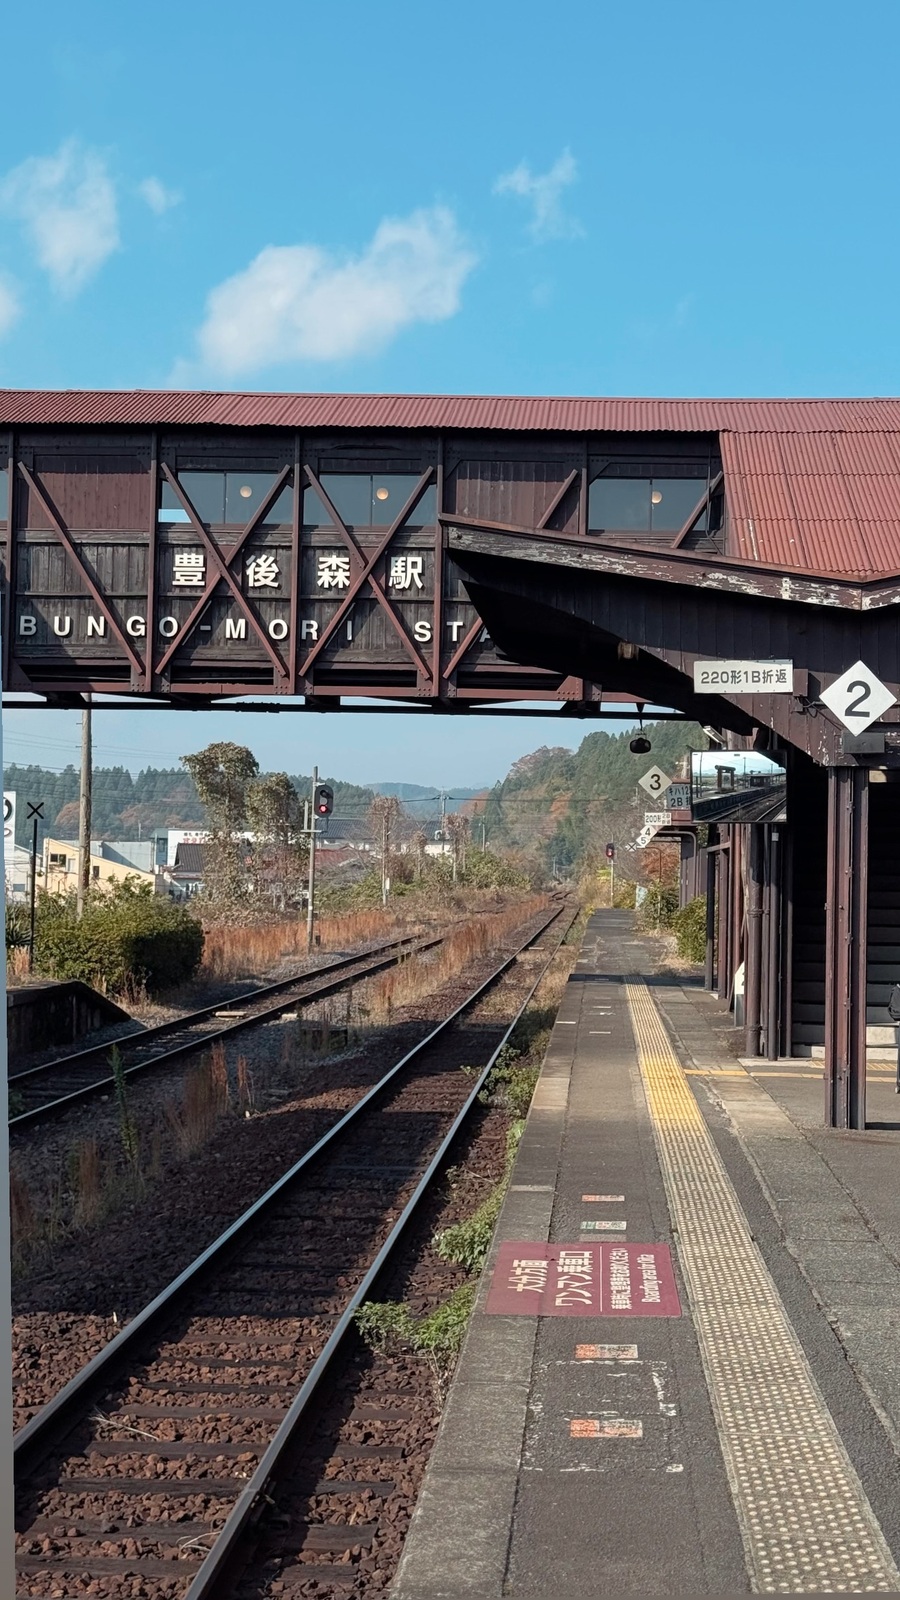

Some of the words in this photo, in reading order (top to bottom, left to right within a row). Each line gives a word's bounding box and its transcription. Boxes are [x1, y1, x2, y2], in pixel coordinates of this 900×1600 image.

[172, 553, 424, 590] 豊後森駅
[18, 615, 354, 641] BUNGO-MORI
[700, 669, 788, 685] 220形1B折返
[844, 680, 872, 718] 2
[649, 773, 662, 791] 3
[668, 785, 691, 796] キハ12
[640, 836, 647, 845] 5
[644, 827, 651, 836] 4
[507, 1259, 549, 1293] 大分方面
[555, 1250, 594, 1307] ワンマン乗車口
[639, 1280, 662, 1303] Boarding
